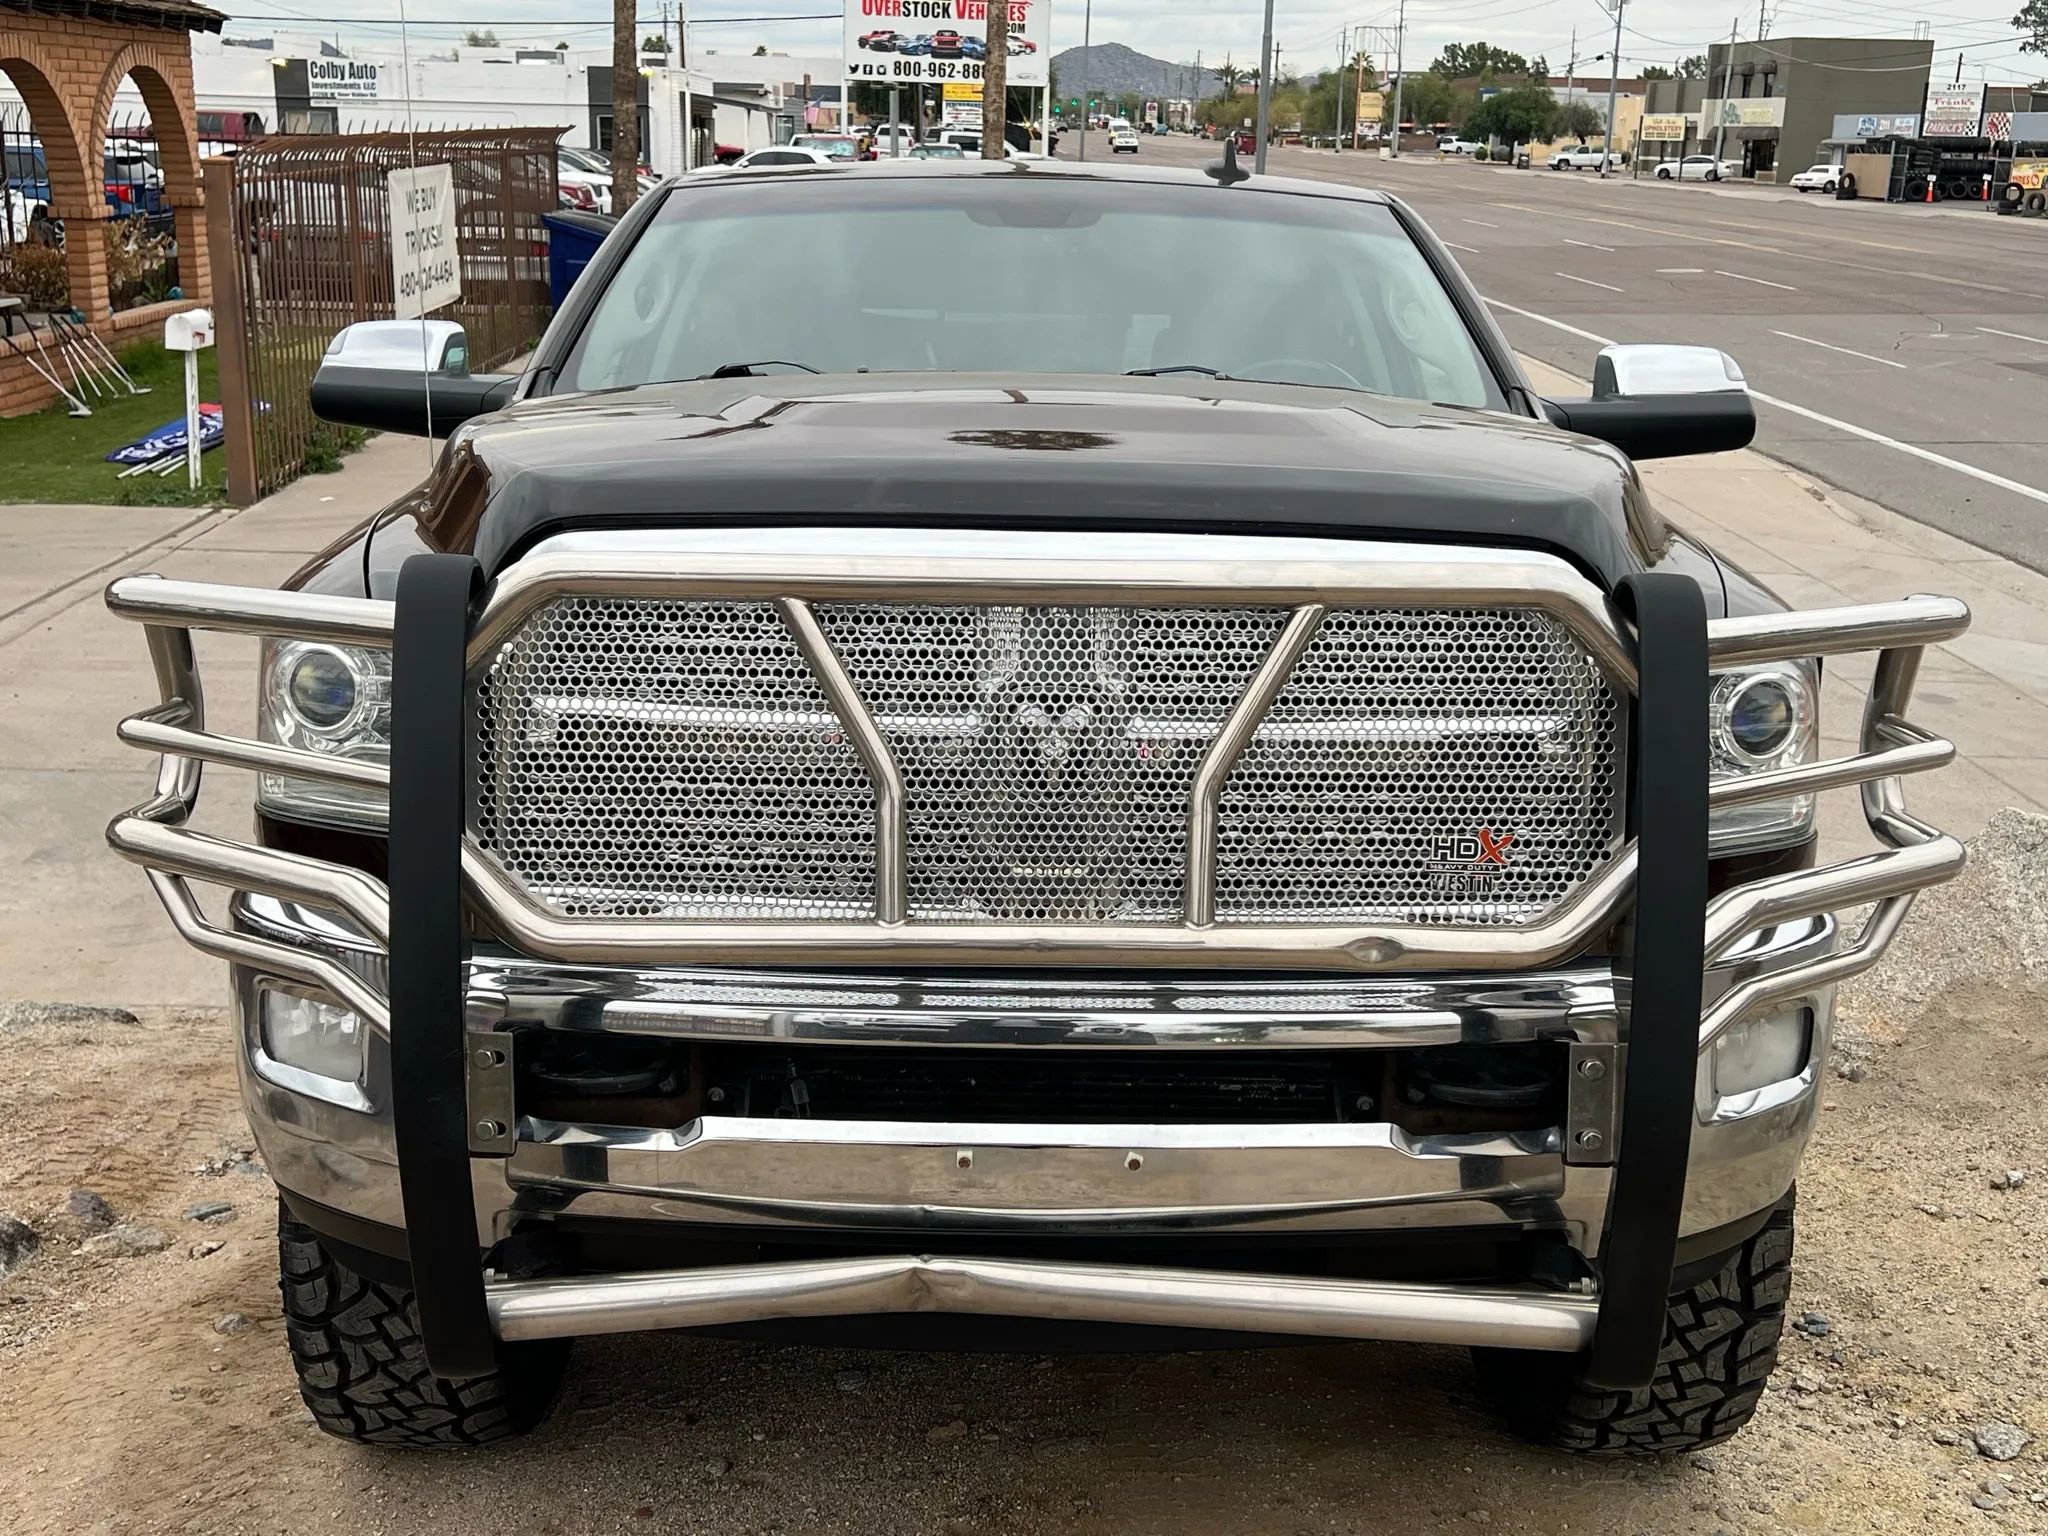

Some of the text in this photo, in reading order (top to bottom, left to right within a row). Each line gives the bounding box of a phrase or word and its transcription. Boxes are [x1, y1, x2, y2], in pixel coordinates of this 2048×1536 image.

[862, 0, 1026, 21] OVERSTOCK VEHES
[310, 61, 376, 80] Colby Auto
[894, 61, 985, 79] 800-962-88
[312, 81, 376, 91] Investments LLC
[405, 185, 436, 215] WE BUY
[1431, 828, 1515, 865] HDX
